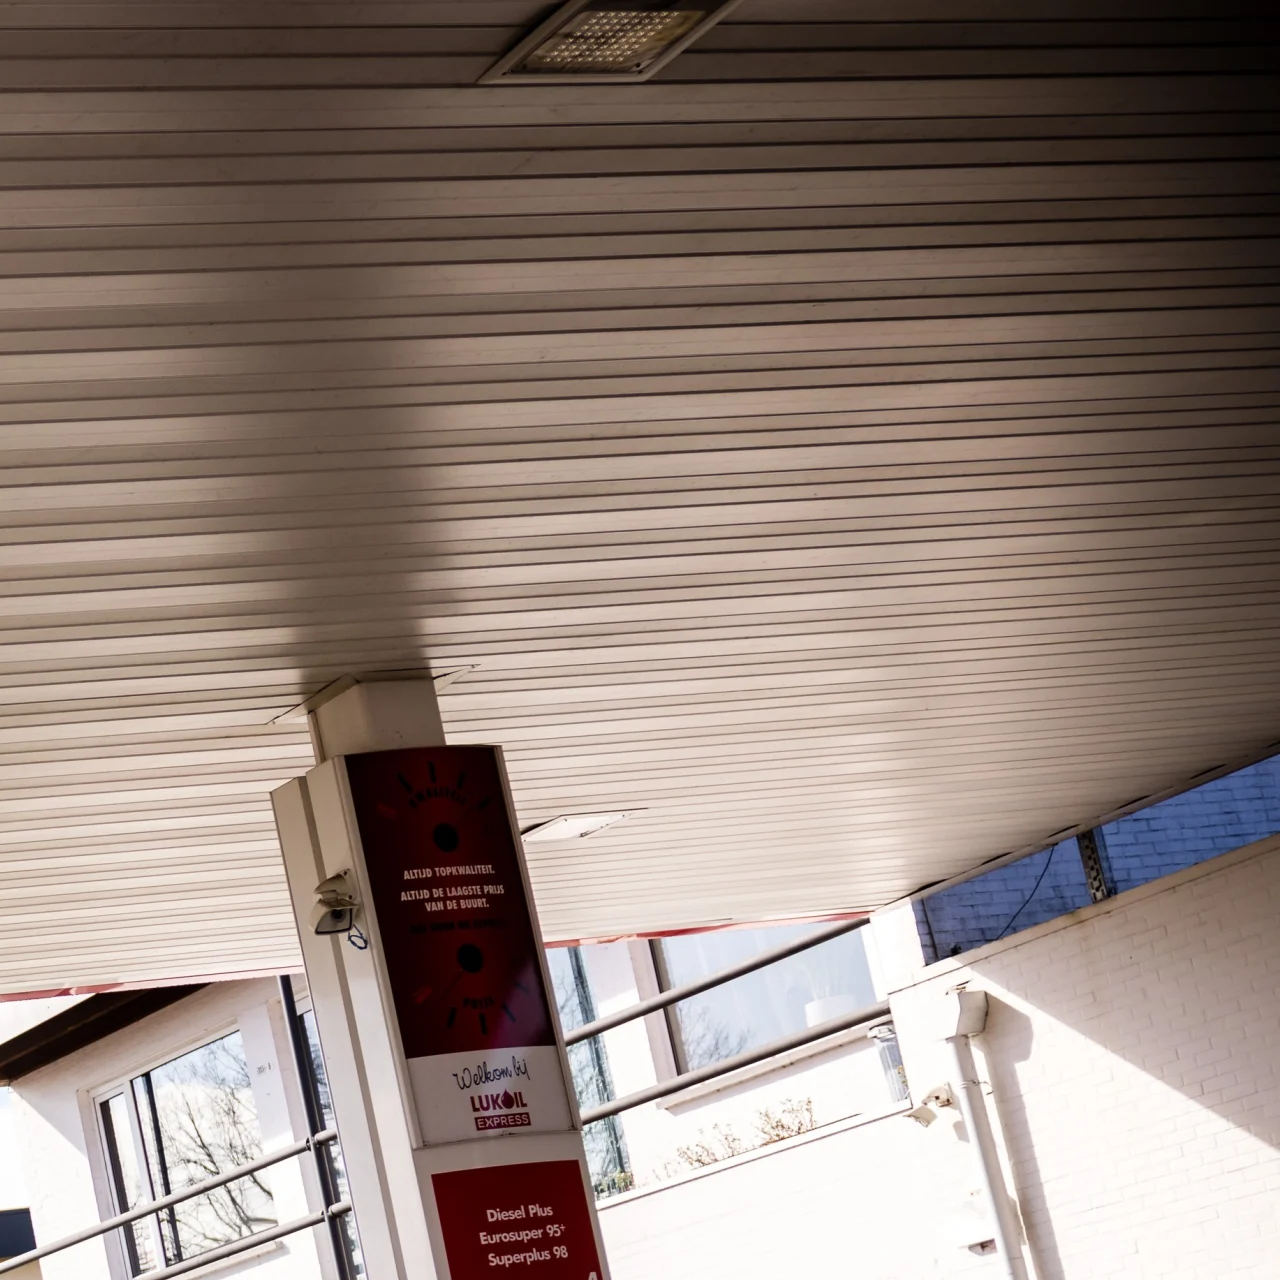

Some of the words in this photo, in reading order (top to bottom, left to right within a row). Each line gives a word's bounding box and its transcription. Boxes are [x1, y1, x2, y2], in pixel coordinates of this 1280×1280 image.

[403, 868, 432, 880] ALTIJD
[434, 864, 495, 877] TOPKWALITEIT.
[400, 890, 430, 901] ALTIJD
[432, 888, 444, 898] DE
[446, 885, 482, 897] LAAGSTE
[483, 884, 505, 894] PRIJS
[425, 901, 444, 911] VAN
[446, 899, 458, 910] DE
[460, 898, 490, 909] BUURT.
[452, 1061, 512, 1090] Welkom
[512, 1055, 531, 1081] bij
[470, 1089, 528, 1112] LUKOIL
[476, 1114, 529, 1129] EXPRESS
[486, 1205, 526, 1222] Diesel
[528, 1203, 553, 1218] Plus
[479, 1227, 544, 1245] Eurosuper
[546, 1223, 566, 1237] 95+
[488, 1247, 551, 1267] Superplus
[553, 1245, 569, 1258] 98
